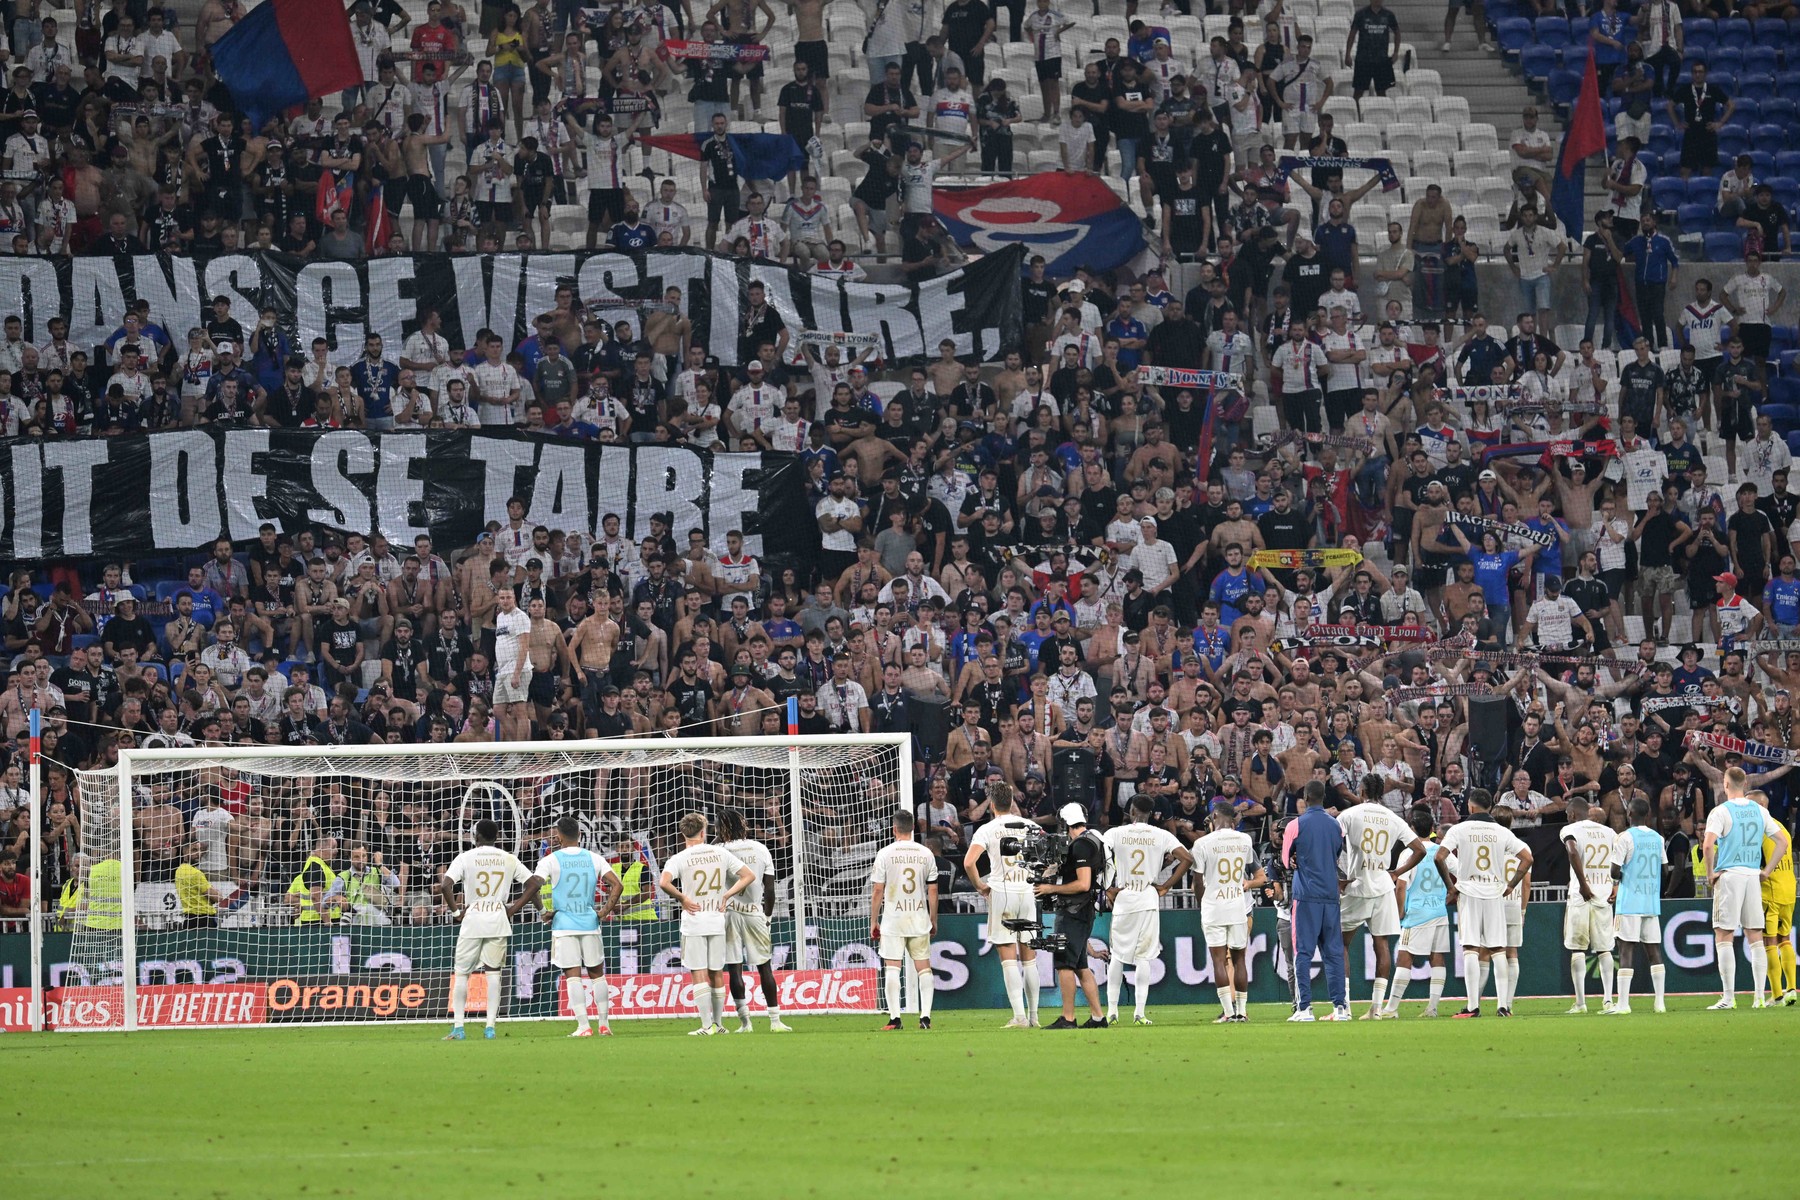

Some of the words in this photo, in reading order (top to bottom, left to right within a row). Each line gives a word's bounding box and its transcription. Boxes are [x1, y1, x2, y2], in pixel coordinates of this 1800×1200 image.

[0, 254, 262, 358] DANS
[297, 256, 416, 363] CE
[1452, 384, 1509, 402] LYON
[0, 440, 108, 558] IT
[149, 429, 284, 548] DE
[308, 430, 430, 546] SE
[470, 434, 764, 557] TAIRE
[1444, 510, 1491, 527] IRAGE
[1507, 525, 1551, 546] NORD
[1311, 625, 1350, 636] Virage
[1390, 626, 1417, 637] Lyon
[1363, 815, 1389, 826] ALVERO
[1740, 821, 1759, 846] 12
[1360, 827, 1389, 855] 80
[1468, 832, 1498, 843] TOLISSO
[474, 858, 505, 868] NUAMAH
[686, 854, 722, 868] LEPENANT
[739, 856, 757, 867] ALDE
[1130, 849, 1145, 876] 2
[1475, 845, 1491, 872] 8
[1584, 844, 1610, 869] 22
[1636, 853, 1659, 880] 20
[475, 870, 505, 898] 37
[693, 868, 722, 897] 24
[902, 867, 916, 895] 3
[1217, 857, 1244, 884] 98
[1419, 868, 1445, 893] 84
[1504, 859, 1517, 883] 6
[566, 872, 589, 899] 21
[267, 979, 427, 1016] Orange
[566, 975, 698, 1010] Betclic
[727, 971, 865, 1005] Betclic
[170, 991, 255, 1023] BETTER
